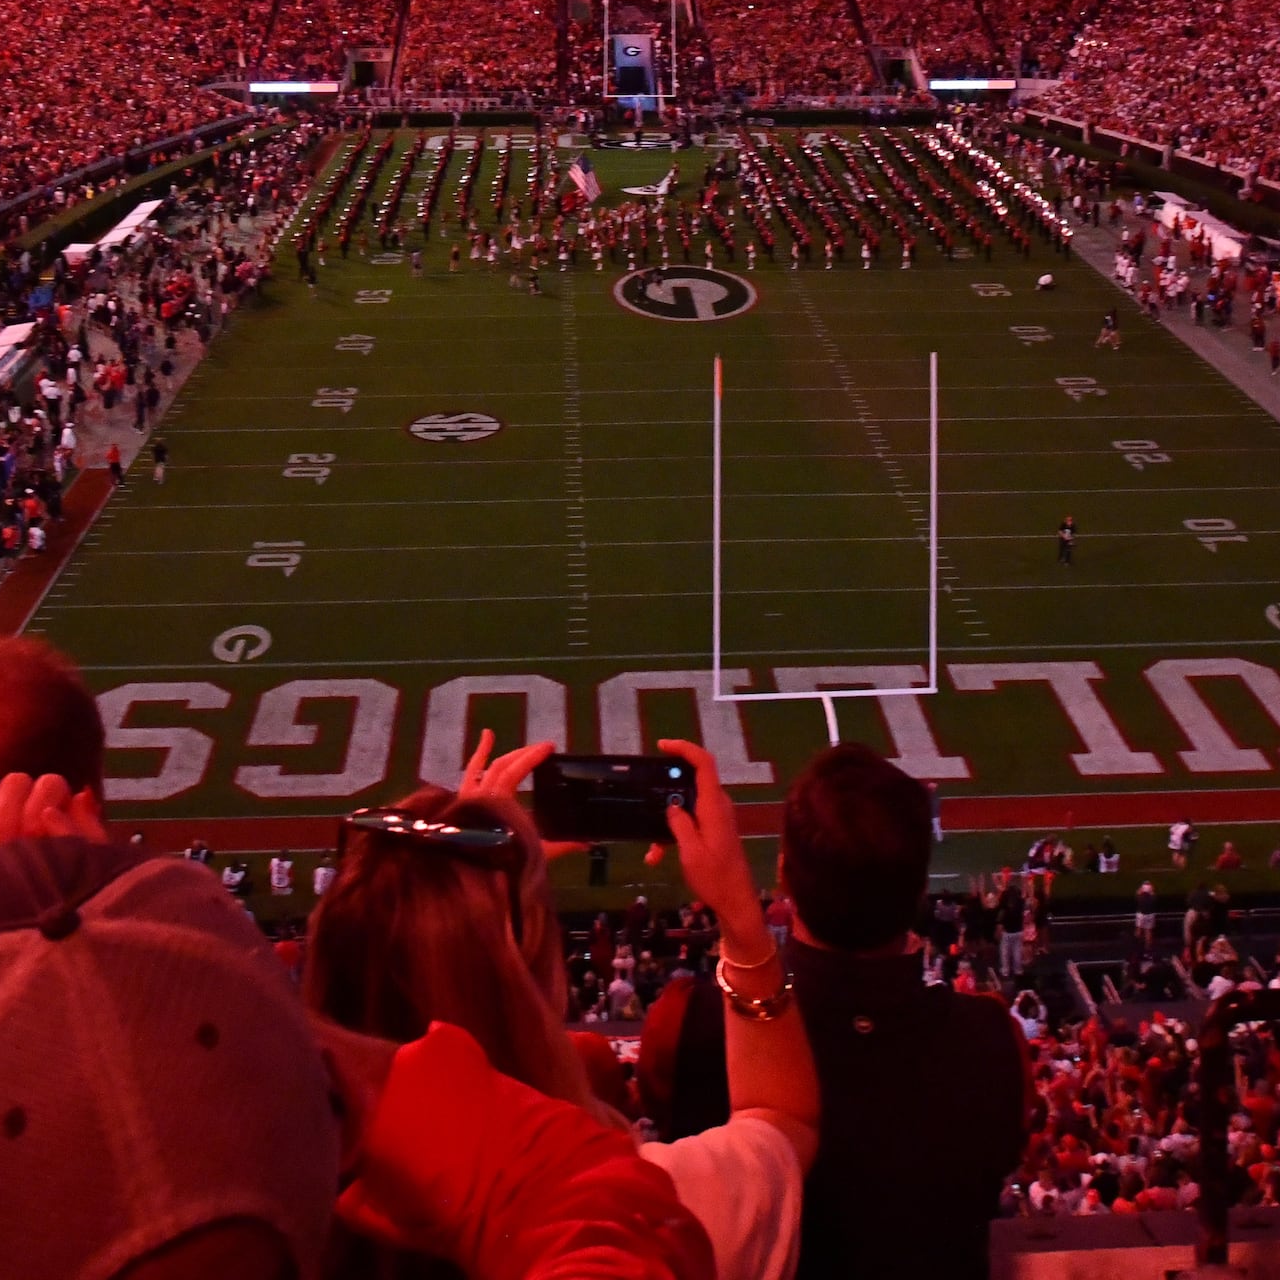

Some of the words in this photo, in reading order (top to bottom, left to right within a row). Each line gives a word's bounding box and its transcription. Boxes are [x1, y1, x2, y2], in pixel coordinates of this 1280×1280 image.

[354, 289, 393, 304] 50
[311, 387, 359, 408] 30
[409, 412, 501, 442] SEC
[282, 452, 337, 478] 20
[1112, 438, 1173, 465] 20
[1182, 518, 1250, 545] 10
[245, 540, 306, 567] 10
[211, 624, 272, 663] G
